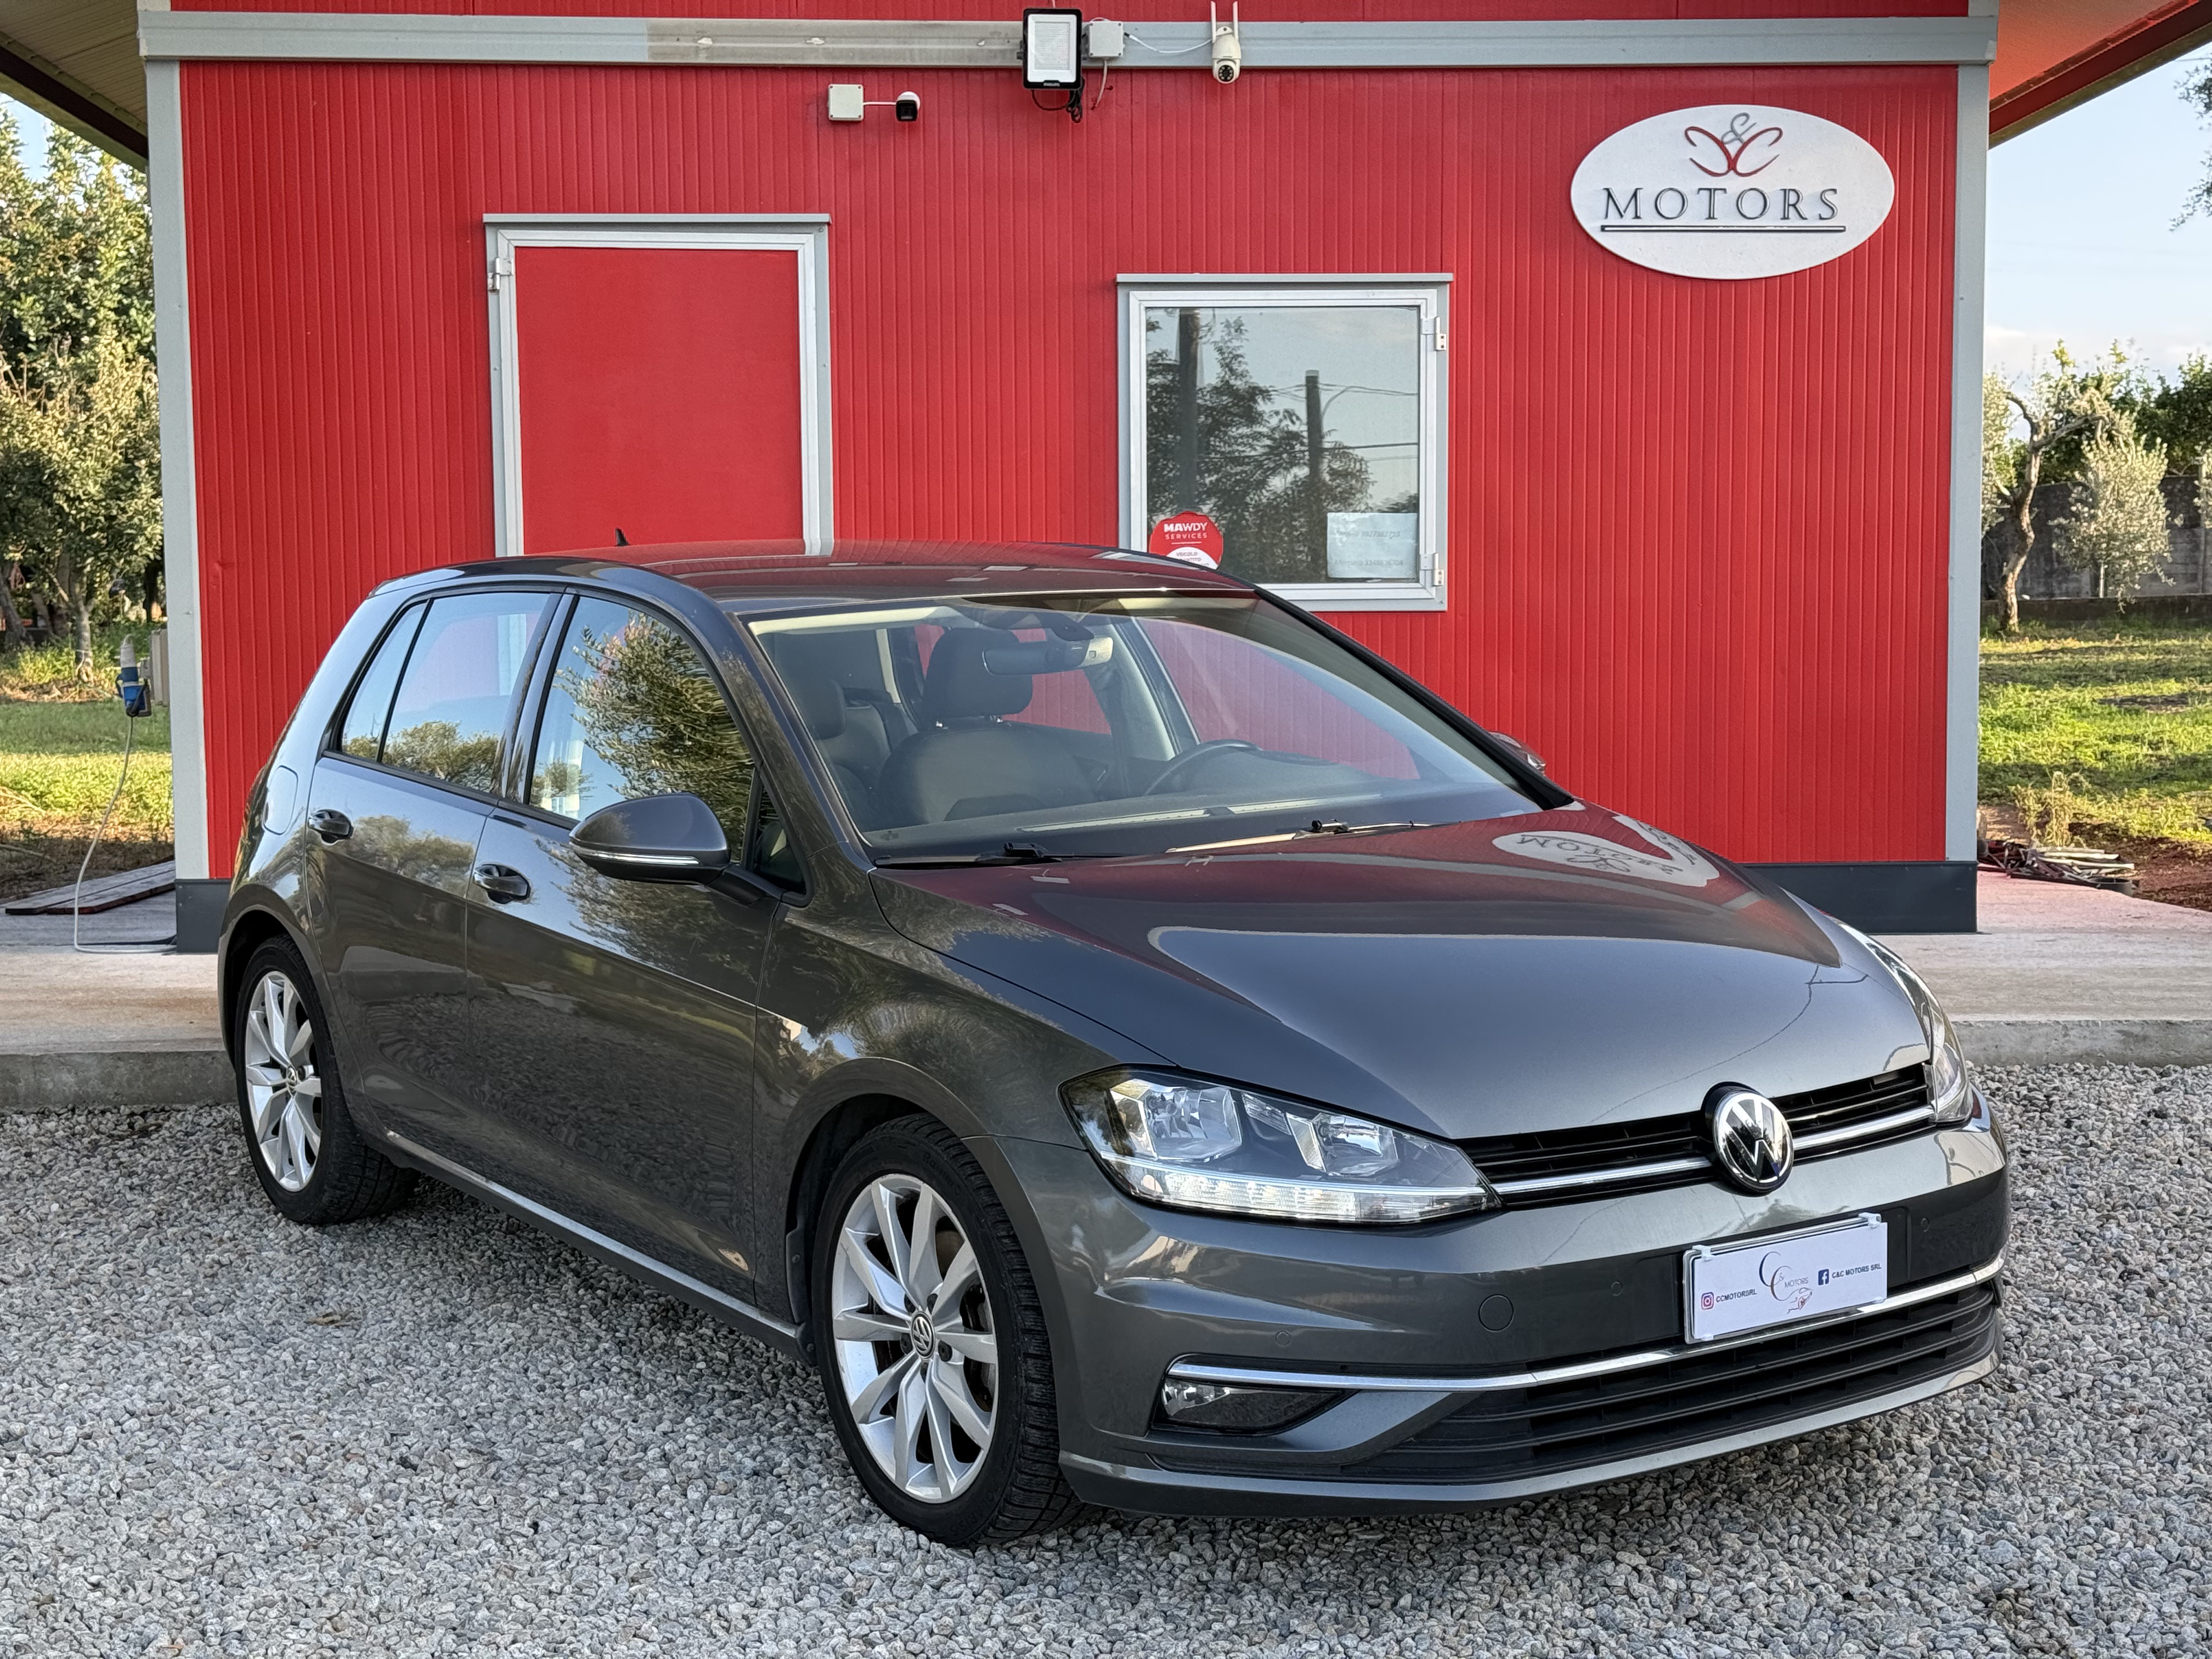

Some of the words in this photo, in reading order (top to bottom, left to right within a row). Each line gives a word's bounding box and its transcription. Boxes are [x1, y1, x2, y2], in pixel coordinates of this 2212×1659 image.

[1602, 187, 1838, 221] MOTORS
[1164, 522, 1208, 533] MAWDY
[1845, 1265, 1870, 1276] MOTORS
[1870, 1263, 1882, 1271] SRL
